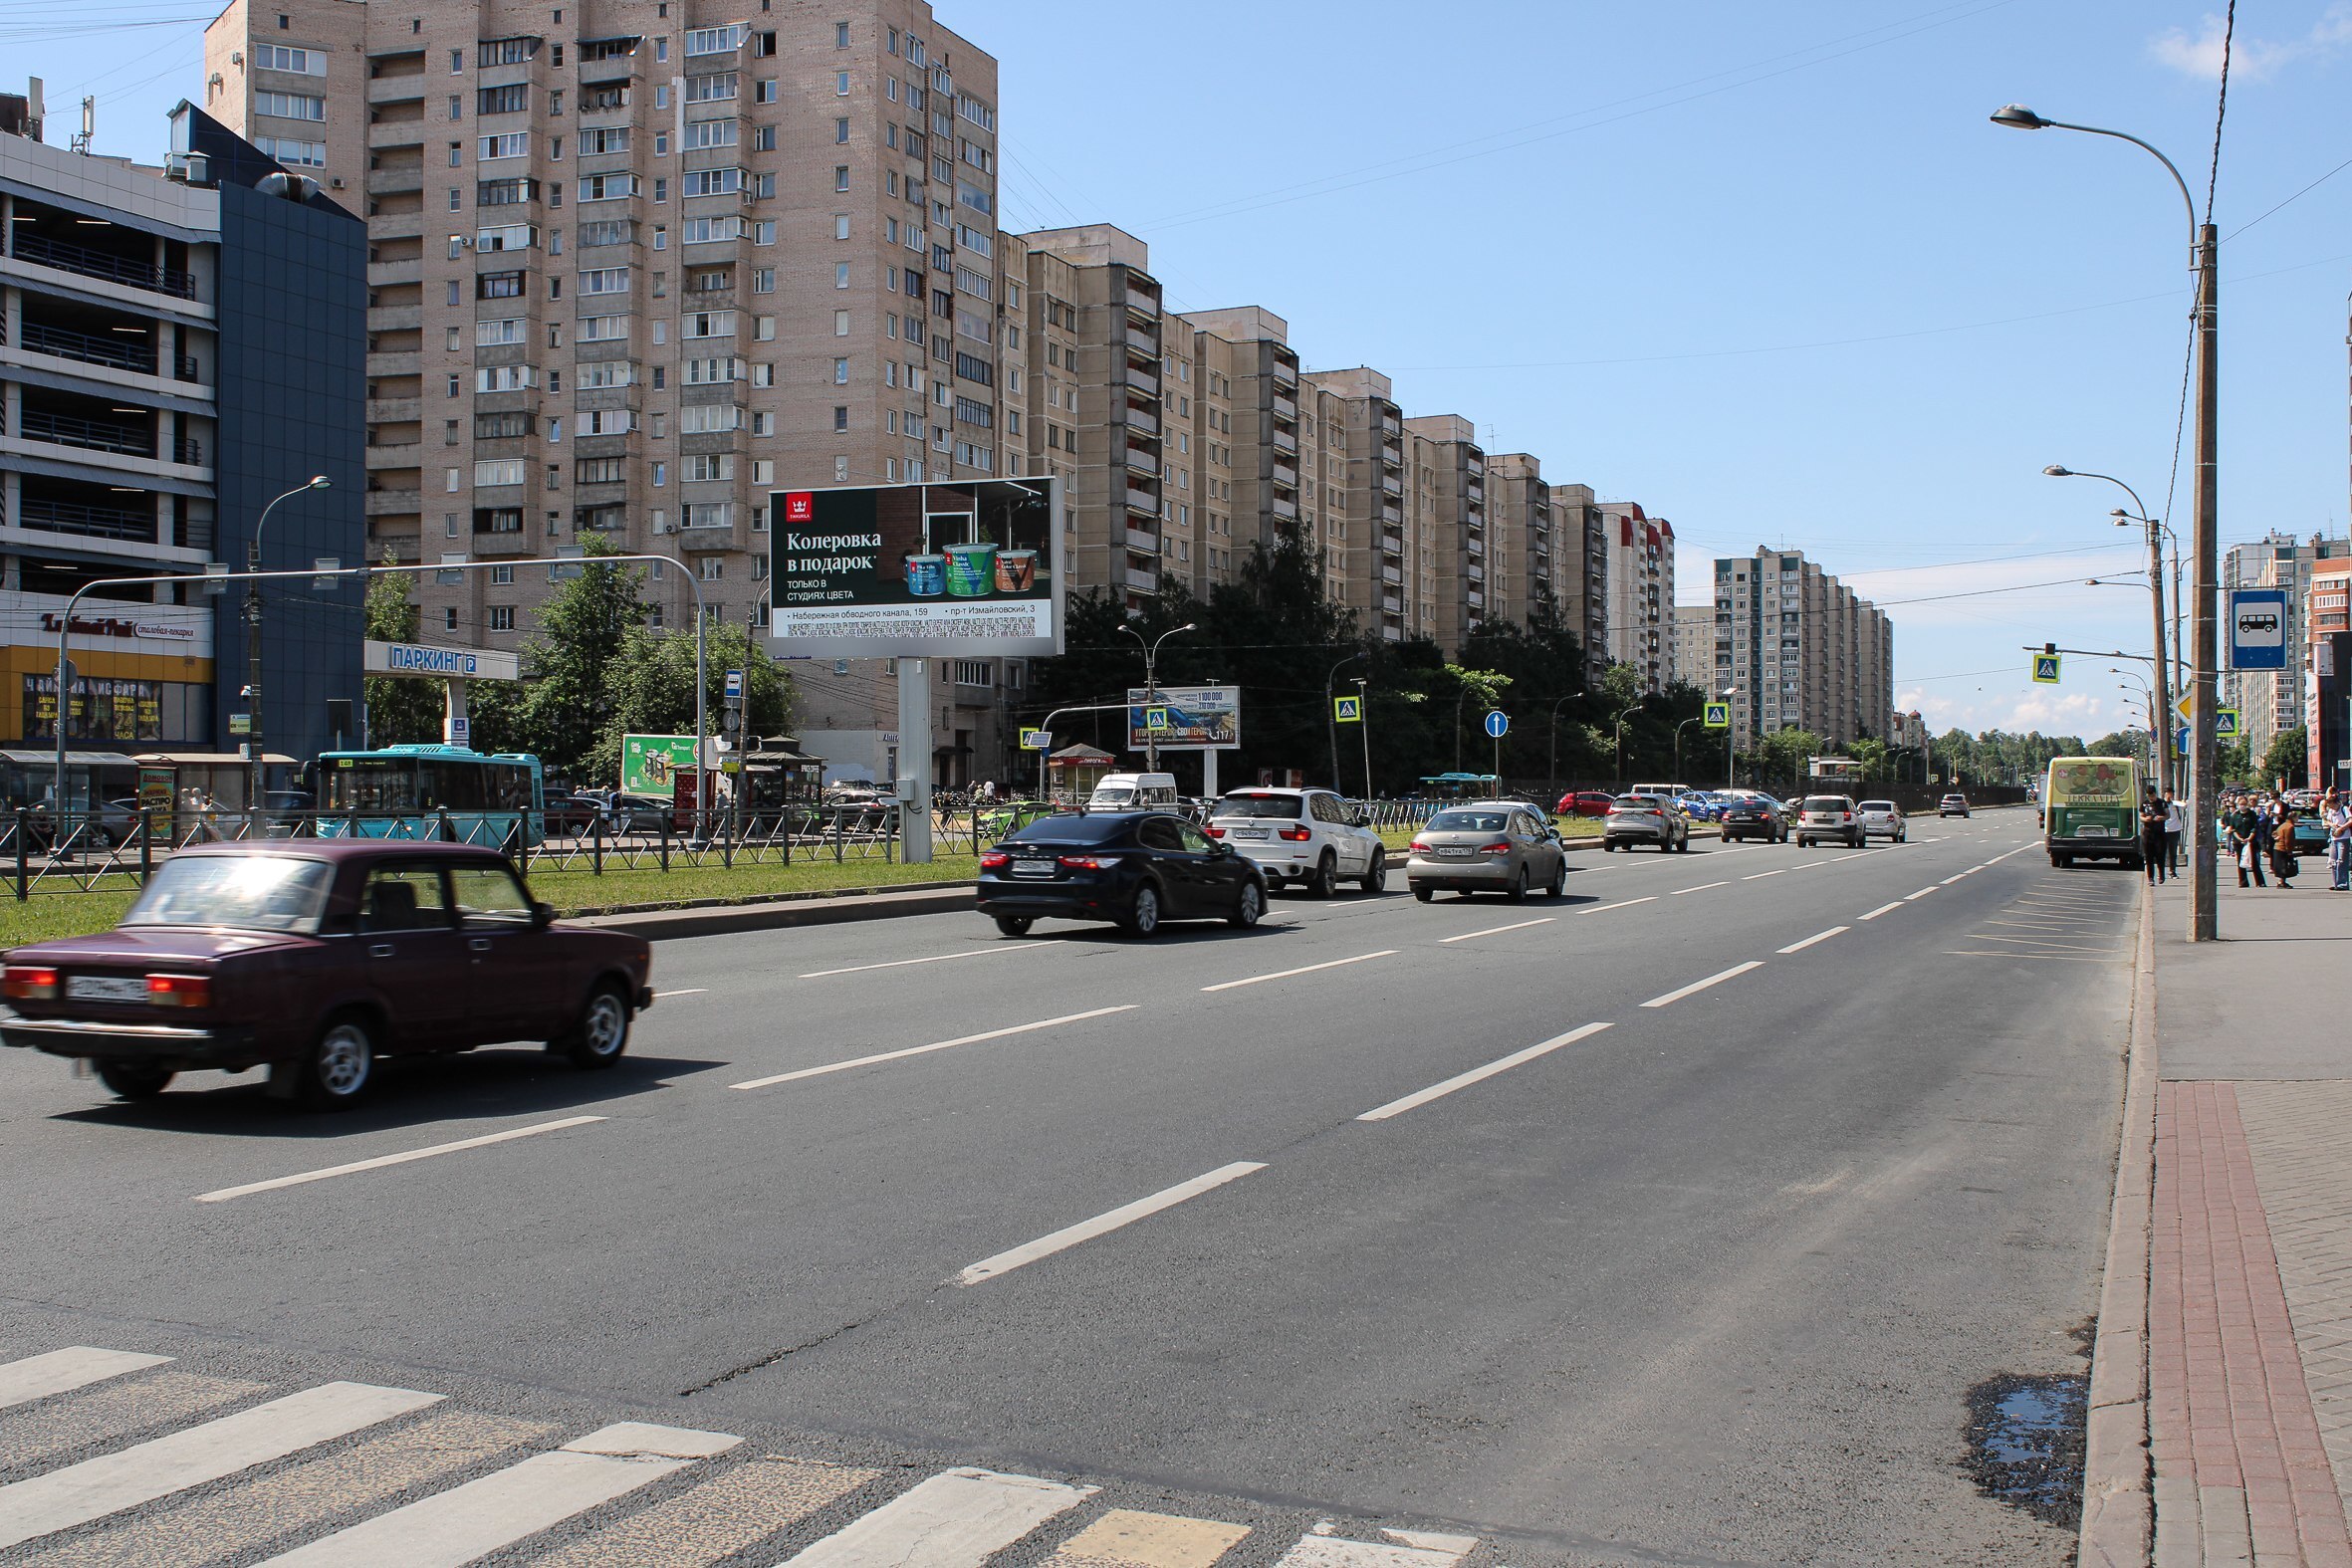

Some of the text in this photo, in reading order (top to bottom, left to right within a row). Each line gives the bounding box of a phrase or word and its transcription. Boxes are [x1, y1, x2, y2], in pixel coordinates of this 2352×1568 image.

[788, 533, 881, 553] Колеровка
[788, 560, 797, 572] в
[787, 579, 826, 589] ТОЛЬКО В
[787, 590, 854, 601] СТУДИЯХ ЦВЕТА
[793, 611, 839, 620] Набережная
[840, 610, 881, 619] обводного
[914, 607, 928, 616] 159
[392, 647, 462, 671] ПАРКИНГ
[98, 682, 144, 697] ИСФАРА
[1216, 731, 1229, 740] 117
